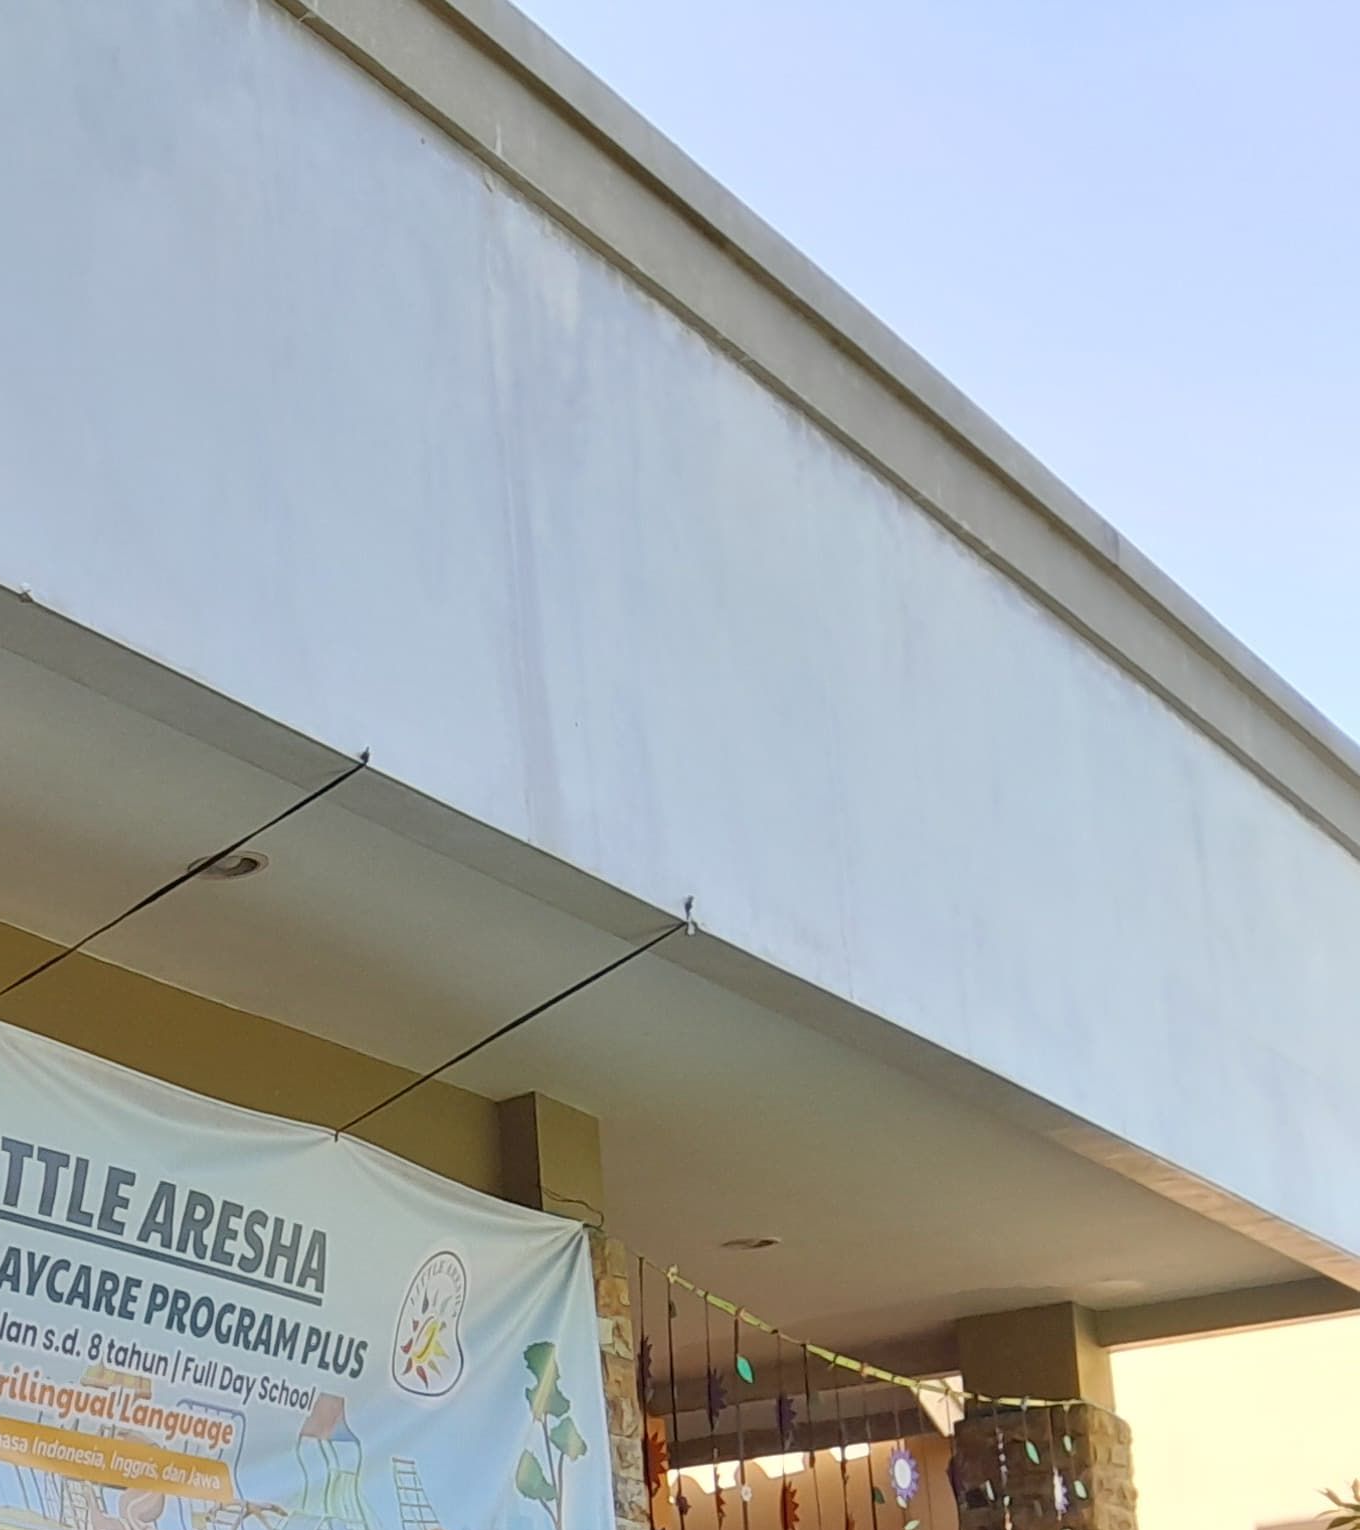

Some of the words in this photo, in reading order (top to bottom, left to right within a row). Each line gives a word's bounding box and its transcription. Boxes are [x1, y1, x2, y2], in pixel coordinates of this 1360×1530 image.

[138, 1180, 327, 1293] ARESHA
[42, 1327, 81, 1357] s.d.
[87, 1333, 102, 1361] 8
[106, 1339, 168, 1376] tahun
[182, 1356, 218, 1389] Full
[219, 1366, 256, 1405] Day
[258, 1376, 316, 1411] School
[143, 1283, 301, 1361] PROGRAM
[300, 1326, 368, 1379] PLUS
[119, 1392, 234, 1449] Language
[31, 1436, 106, 1471] Indonesia,
[161, 1464, 186, 1484] dan
[187, 1468, 222, 1490] Jawa
